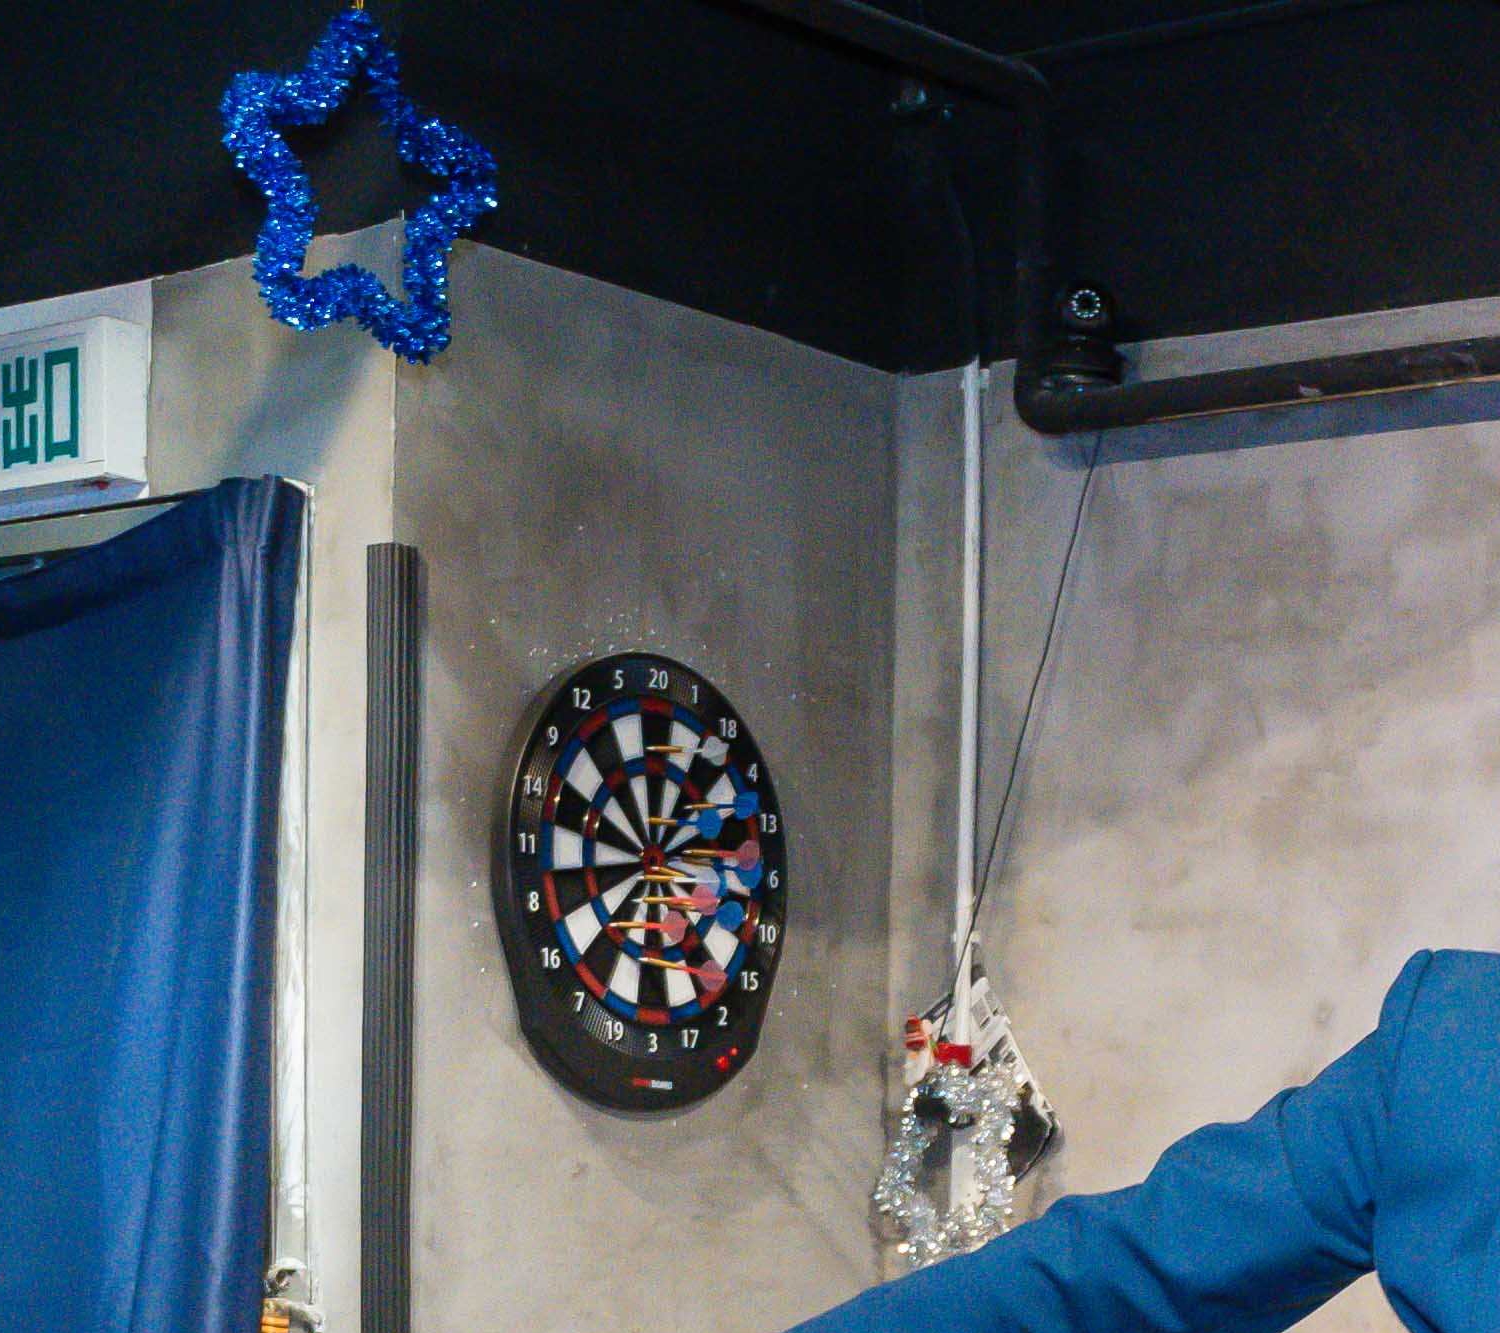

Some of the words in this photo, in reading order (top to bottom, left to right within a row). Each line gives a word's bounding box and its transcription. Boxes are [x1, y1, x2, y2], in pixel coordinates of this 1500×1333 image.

[2, 346, 79, 469] 出口
[614, 669, 624, 690] 5
[648, 668, 669, 690] 20
[573, 687, 591, 710] 12
[691, 685, 698, 704] 1
[548, 726, 559, 747] 9
[719, 717, 737, 739] 18
[748, 762, 758, 783] 4
[523, 775, 543, 797] 14
[760, 812, 777, 833] 13
[519, 833, 536, 855] 11
[769, 869, 779, 889] 6
[528, 891, 540, 912] 8
[759, 924, 777, 943] 10
[541, 947, 561, 969] 16
[741, 970, 759, 991] 15
[575, 992, 584, 1012] 7
[718, 1006, 728, 1027] 2
[605, 1020, 625, 1041] 19
[680, 1028, 699, 1049] 17
[648, 1033, 658, 1053] 3
